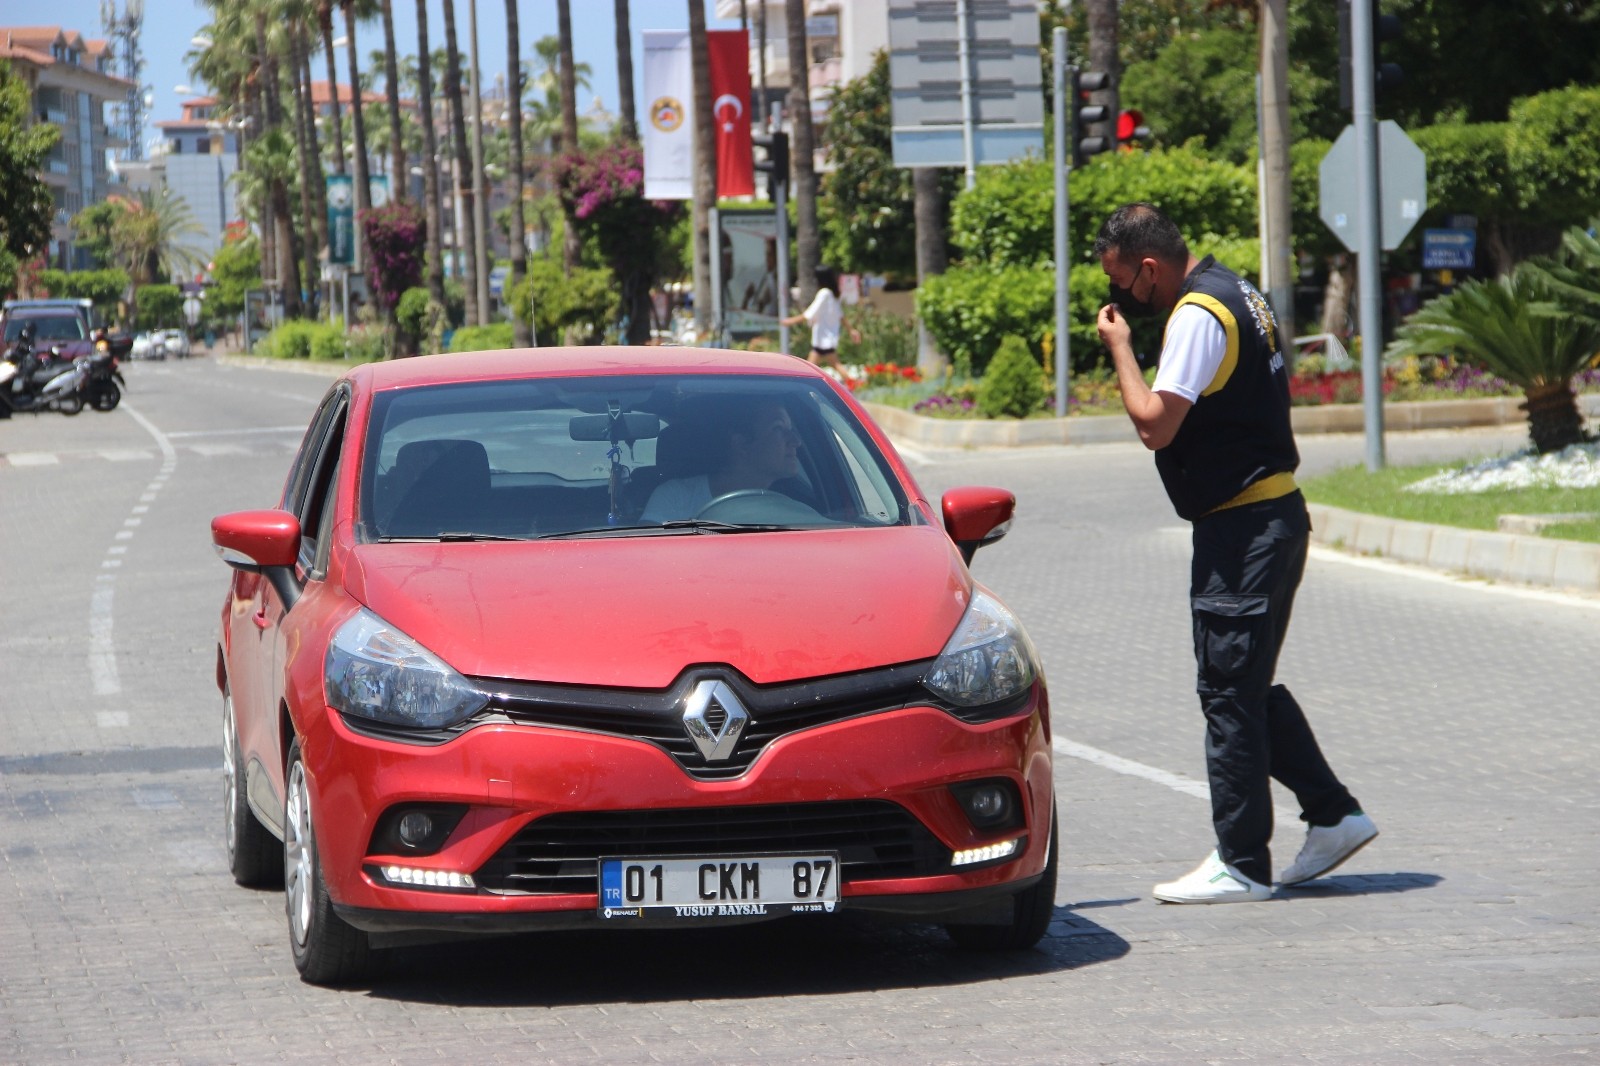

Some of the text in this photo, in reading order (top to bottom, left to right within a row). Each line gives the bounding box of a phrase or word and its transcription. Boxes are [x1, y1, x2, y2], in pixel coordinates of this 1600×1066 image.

[625, 860, 832, 903] 01 CKM 87
[605, 888, 620, 899] TR
[675, 904, 767, 917] YUSUF BAYSAL
